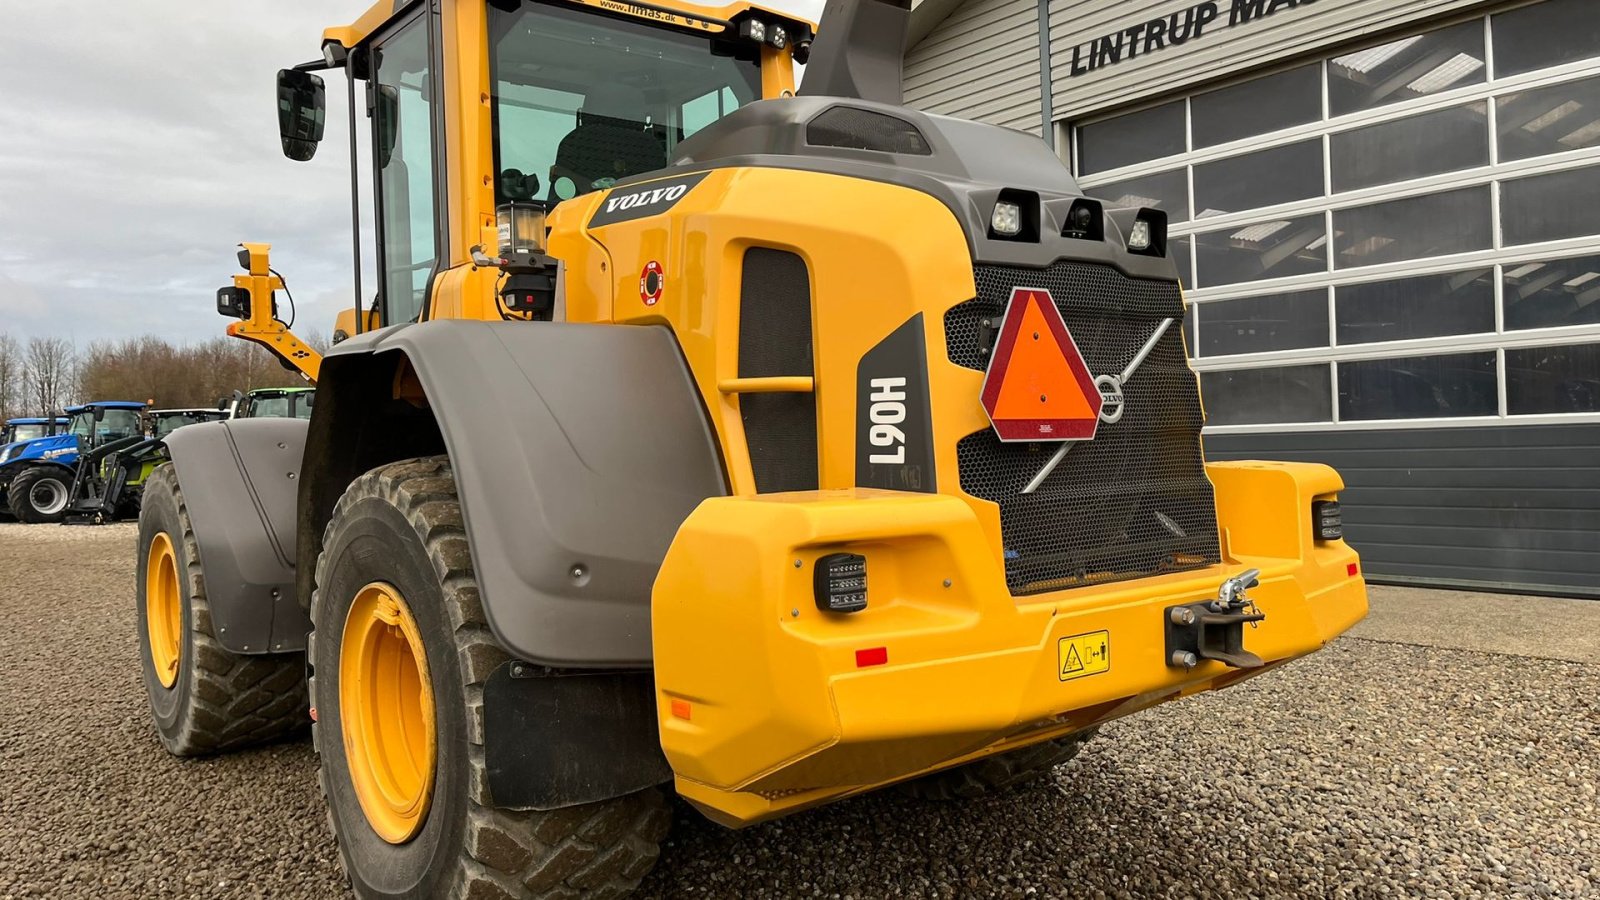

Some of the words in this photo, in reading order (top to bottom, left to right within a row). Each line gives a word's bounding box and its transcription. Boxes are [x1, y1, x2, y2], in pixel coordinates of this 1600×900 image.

[1069, 3, 1218, 77] LINTRUP
[606, 184, 688, 213] VOLVO
[869, 377, 906, 464] L90H
[1103, 394, 1123, 403] OLVO
